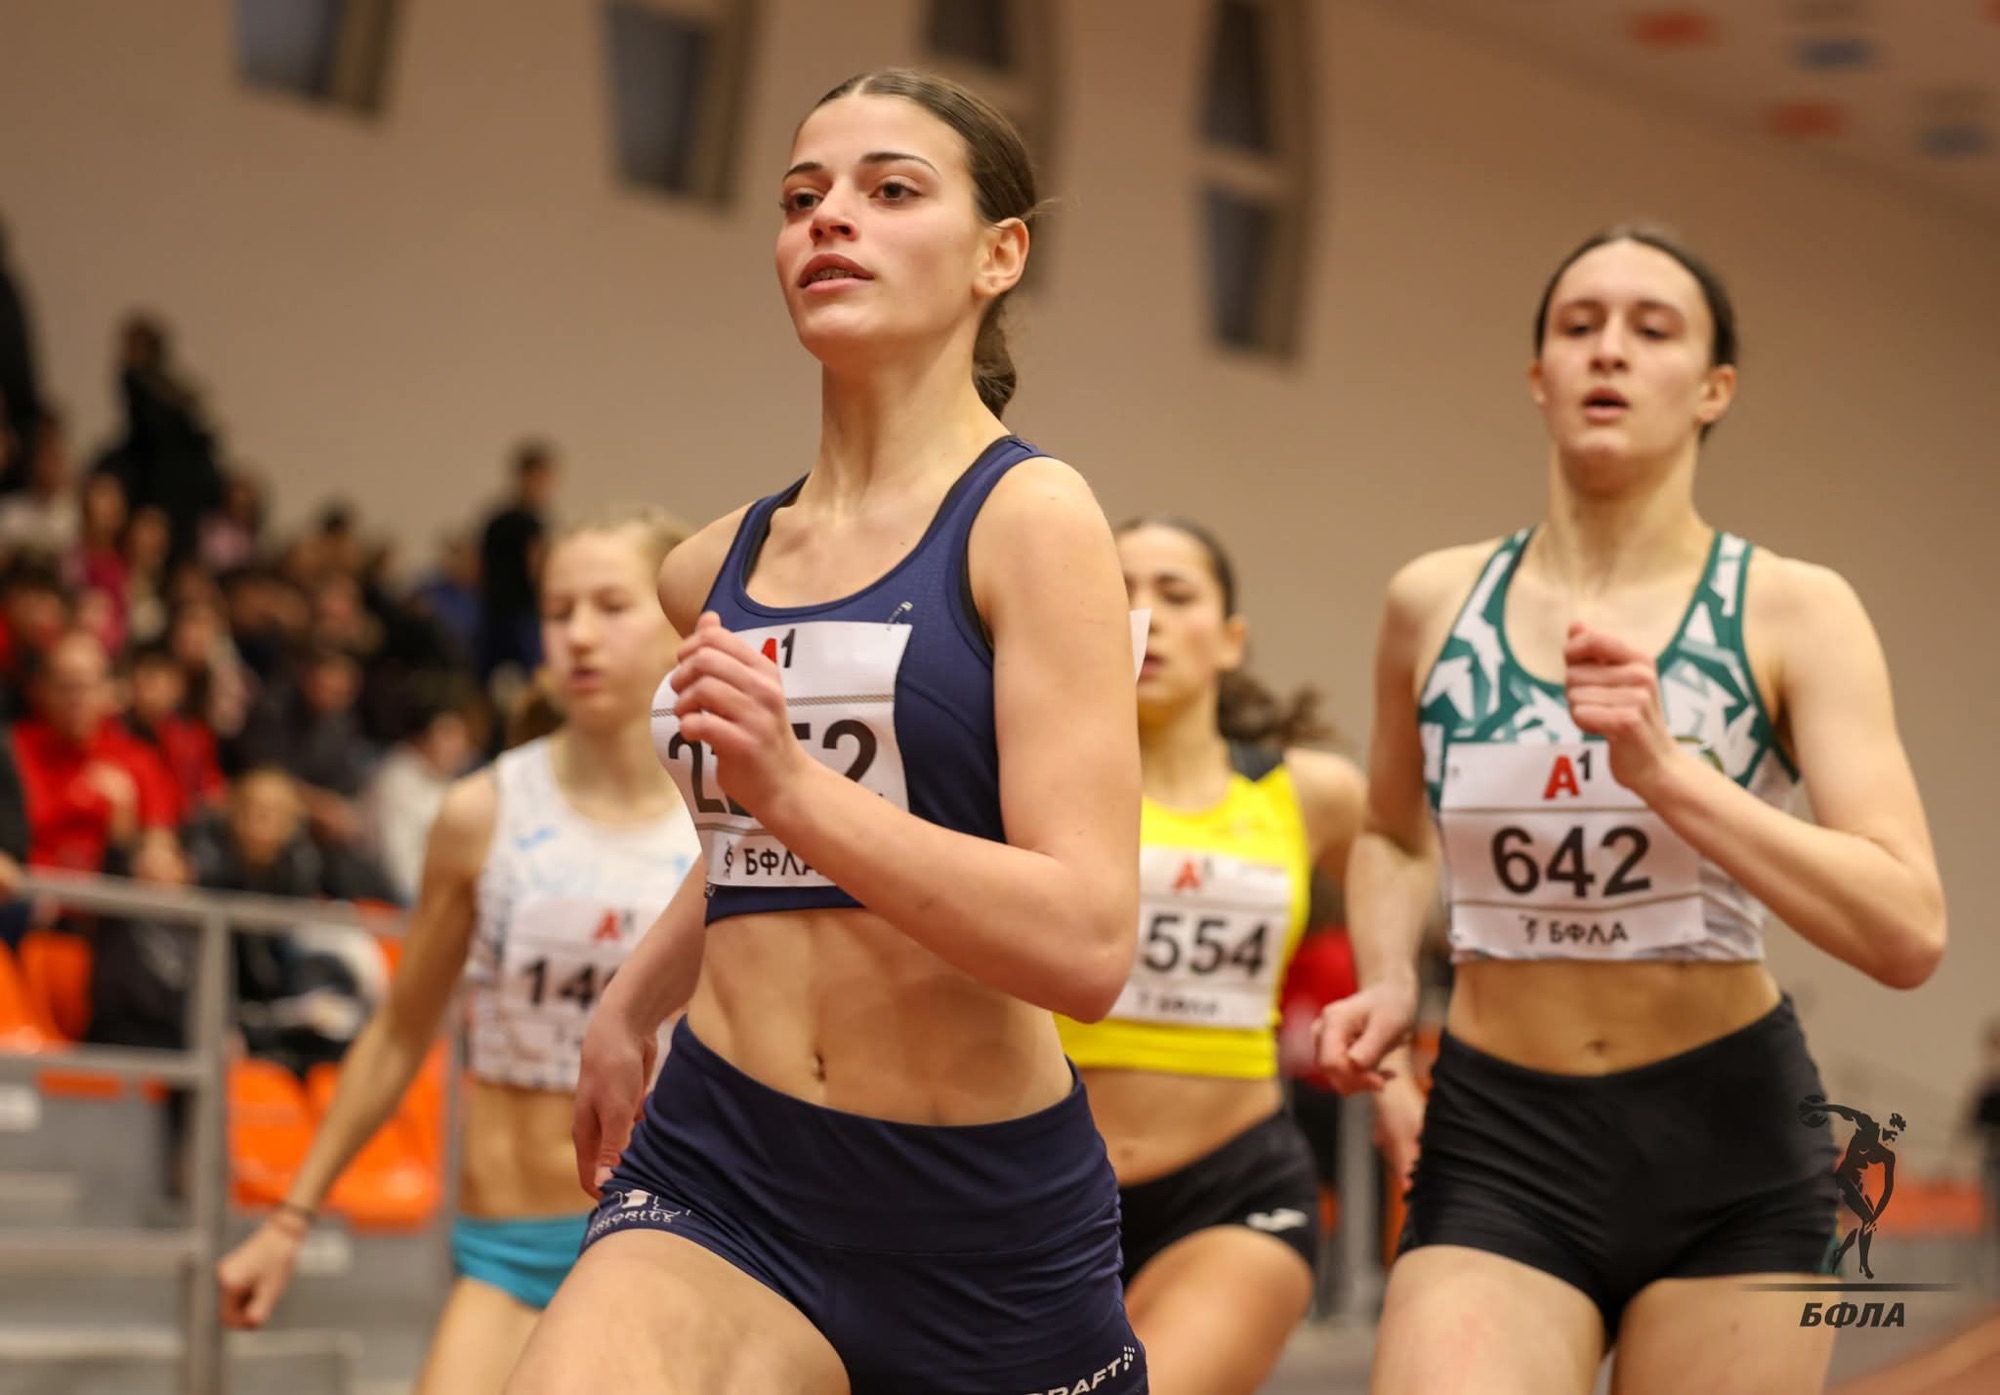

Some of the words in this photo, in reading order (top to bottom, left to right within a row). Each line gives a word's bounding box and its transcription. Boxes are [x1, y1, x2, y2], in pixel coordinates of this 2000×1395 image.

[1543, 750, 1593, 800] A1
[1491, 826, 1652, 898] 642
[1549, 921, 1630, 944] БФЛА
[522, 954, 618, 1012] 14
